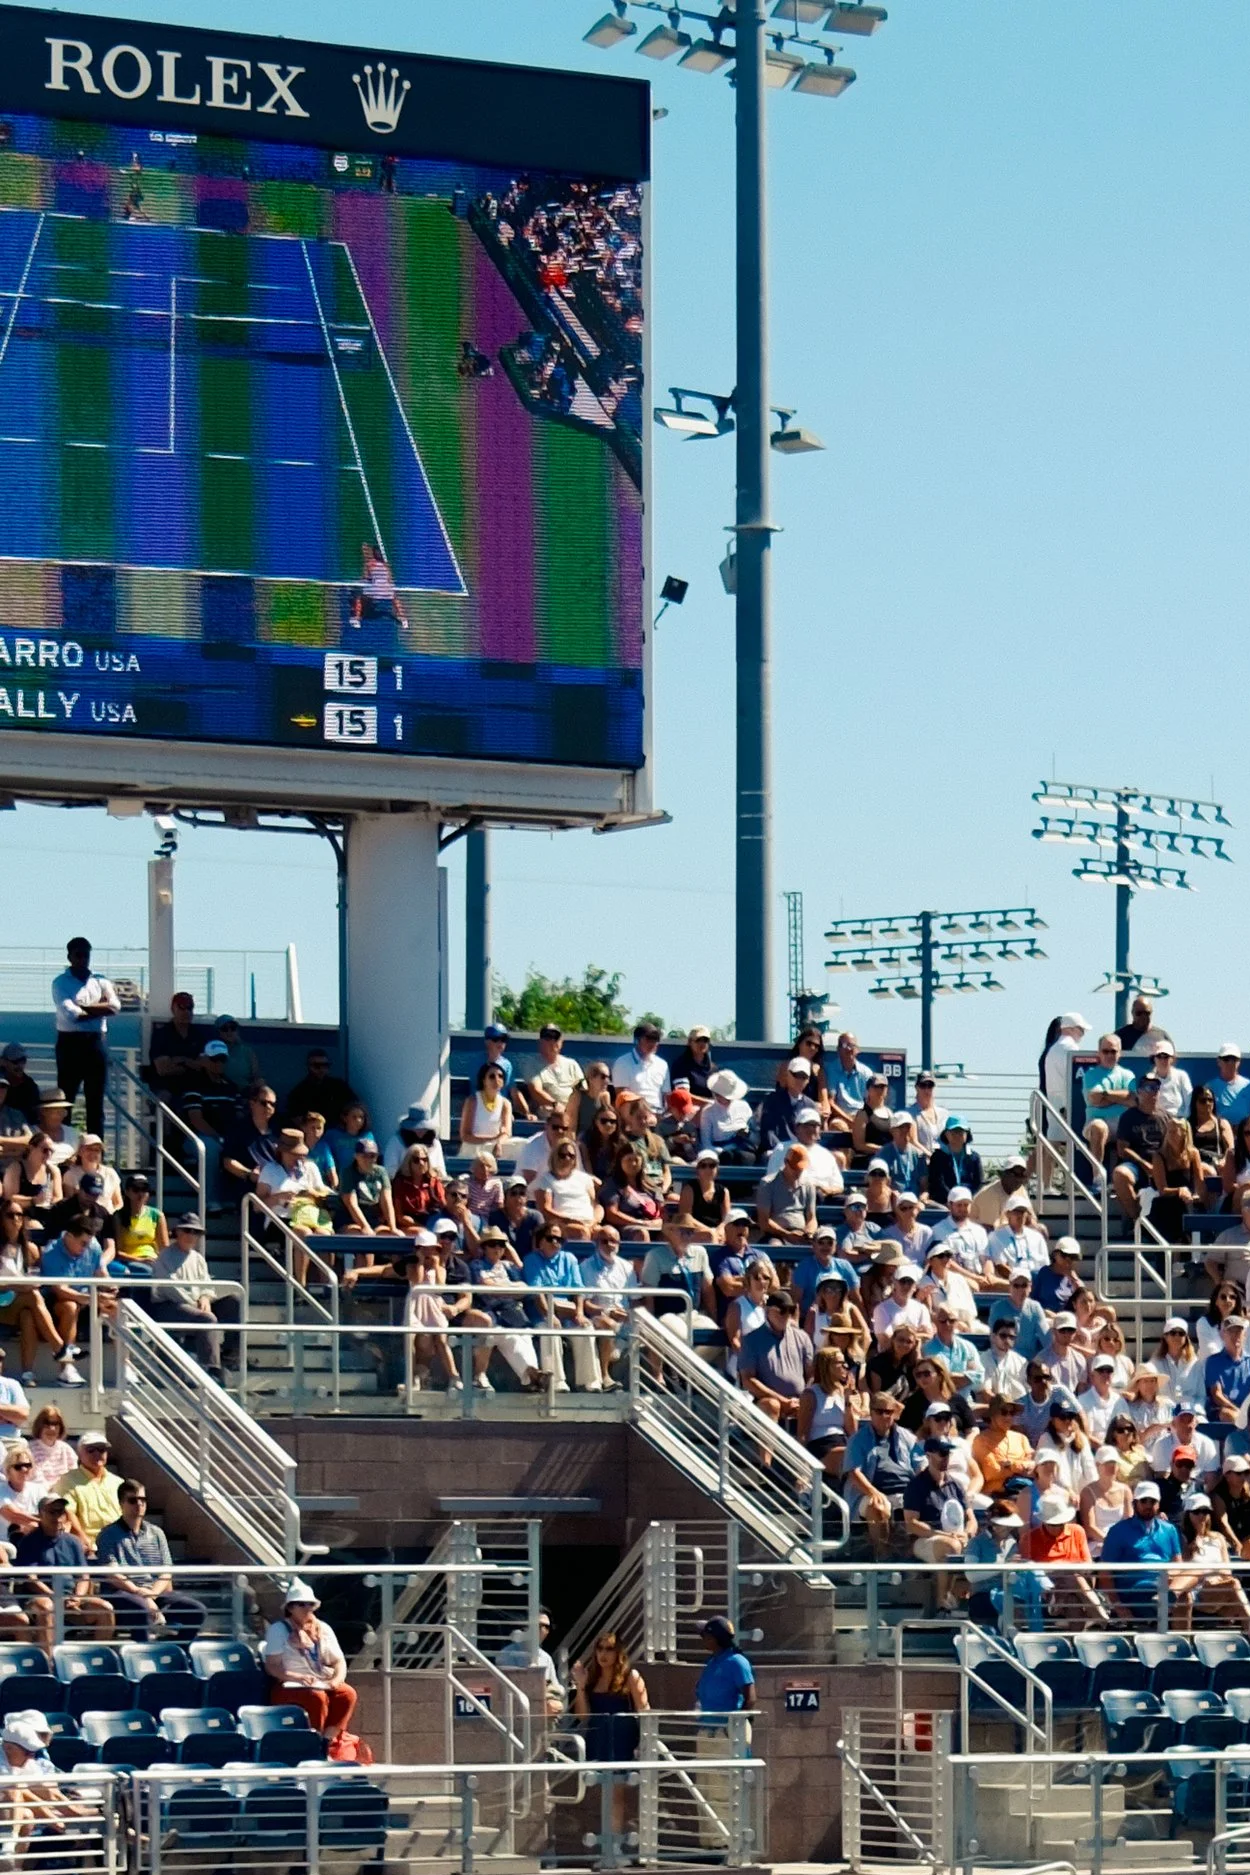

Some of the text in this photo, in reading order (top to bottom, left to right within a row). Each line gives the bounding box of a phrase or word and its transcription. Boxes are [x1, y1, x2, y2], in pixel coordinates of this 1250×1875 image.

[44, 37, 310, 118] ROLEX
[96, 650, 141, 672] USA
[335, 660, 367, 687] 15
[392, 664, 403, 690] 1
[0, 687, 403, 740] ALLY USA 15 1
[459, 1699, 475, 1713] 16
[789, 1693, 818, 1707] 17 A
